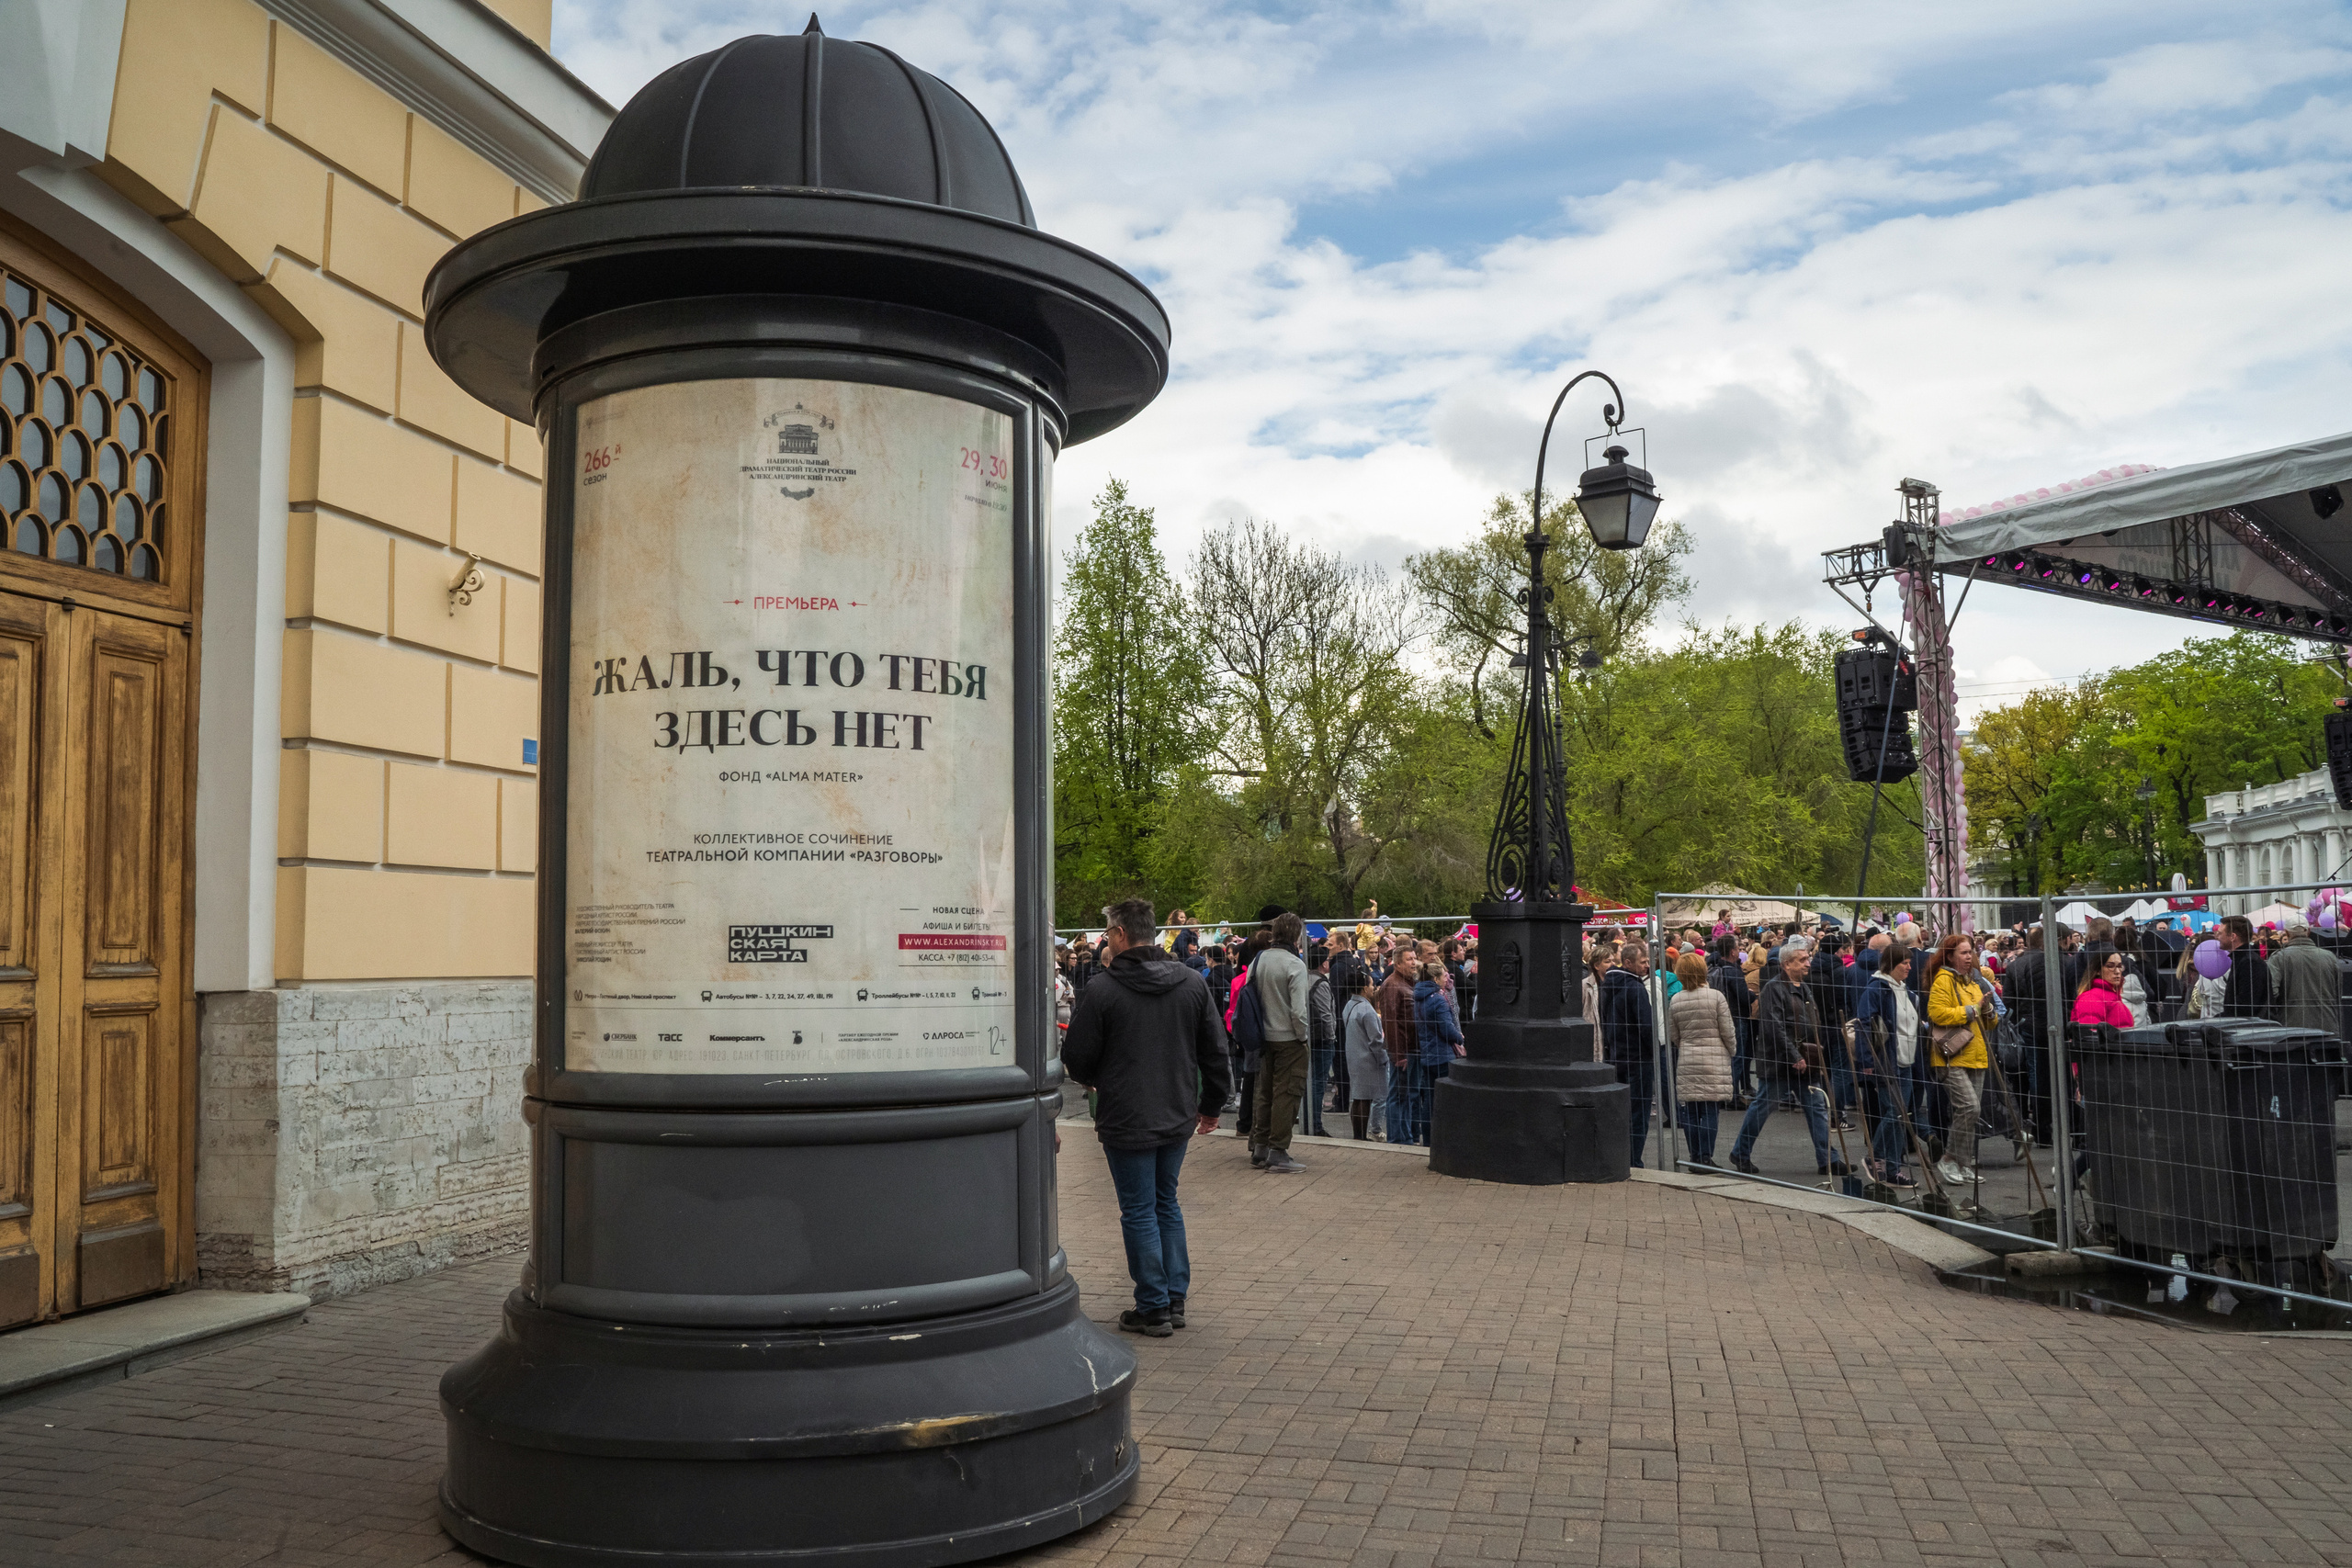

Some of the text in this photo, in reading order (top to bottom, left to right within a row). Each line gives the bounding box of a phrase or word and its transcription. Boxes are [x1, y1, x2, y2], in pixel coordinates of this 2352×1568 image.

[989, 455, 1007, 479] 30
[583, 473, 607, 486] сезон
[753, 597, 839, 611] ПРЕМЬЕРА
[592, 649, 988, 701] ЖАЛЬ, ЧТО ТЕБЯ
[653, 709, 932, 754] ЗДЕСЬ НЕТ
[718, 771, 761, 784] ФОНД
[694, 833, 893, 845] КОЛЛЕКТИВНОЕ СОЧИНЕНИЕ
[646, 847, 943, 863] ТЕАТРАЛЬНОЙ КОМПАНИИ «РАЗГОВОРЫ»
[961, 907, 985, 915] СЦЕНА
[730, 927, 831, 937] ПУШКИН
[922, 922, 953, 931] АФИША
[730, 939, 786, 949] СКАЯ
[904, 938, 1003, 947] WWW.ALEXANDRINSKY.RU
[730, 951, 805, 961] КАРТА
[709, 1034, 765, 1043] Коммерсантъ
[987, 1025, 1008, 1055] 12+
